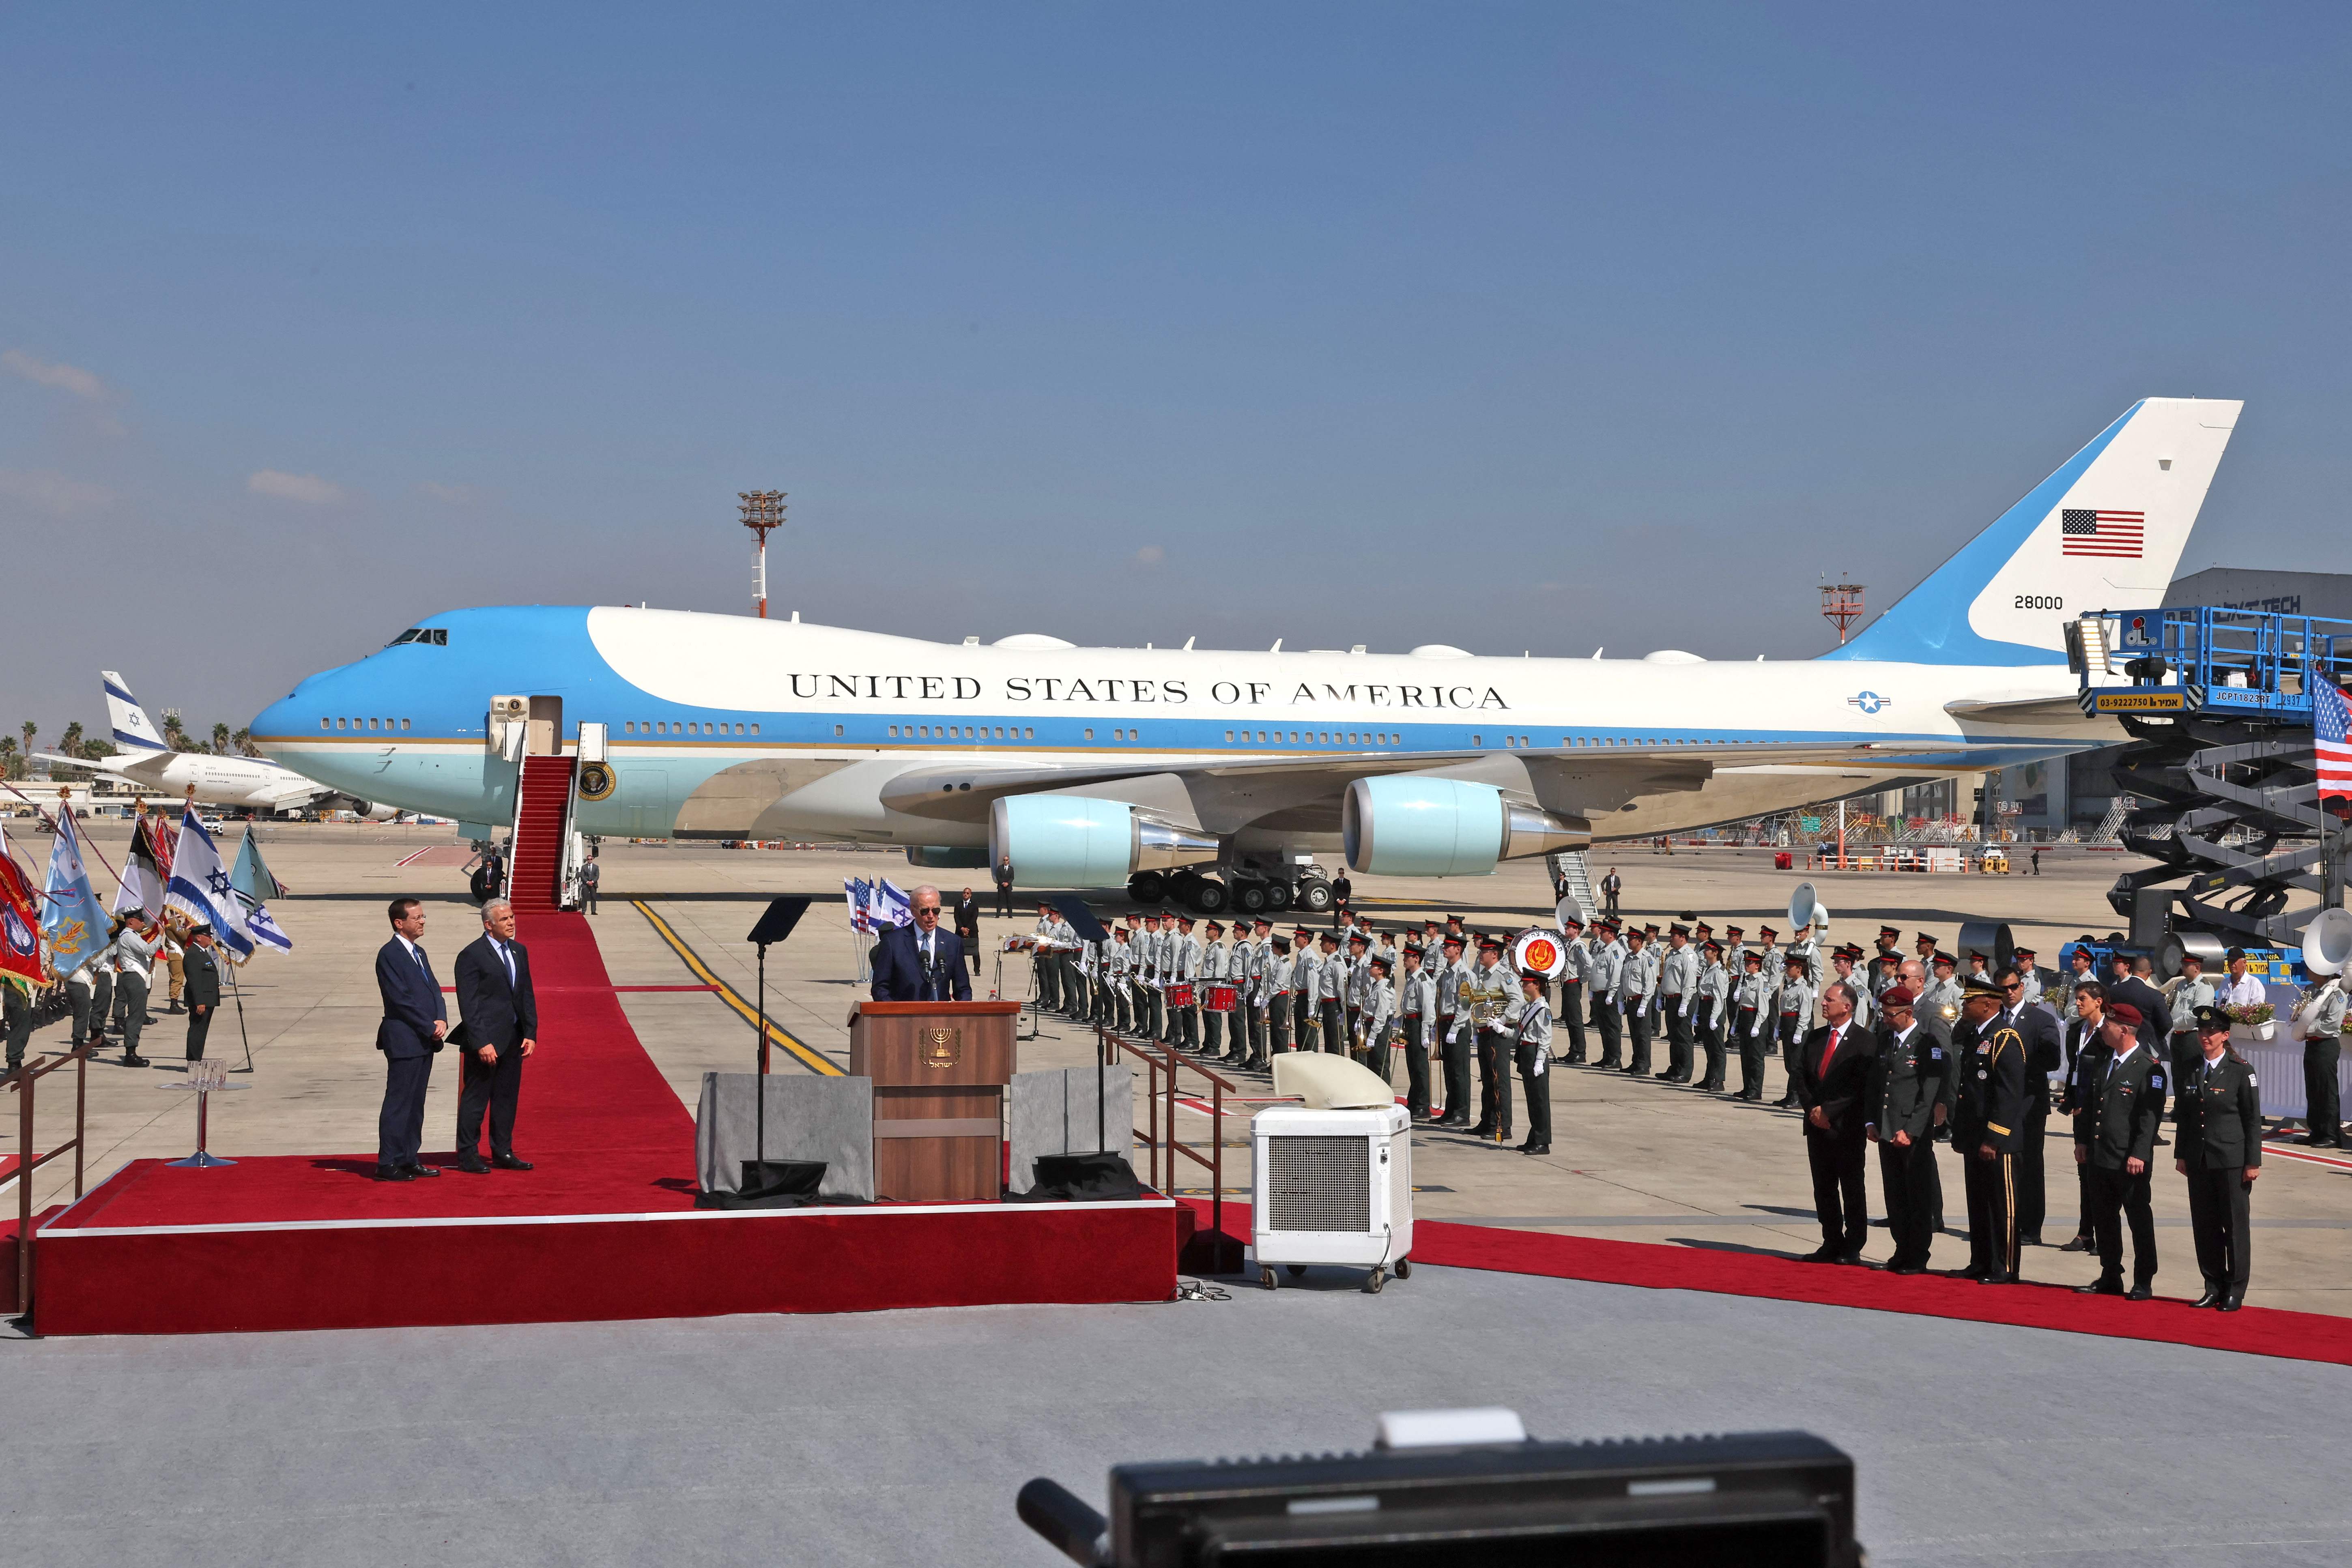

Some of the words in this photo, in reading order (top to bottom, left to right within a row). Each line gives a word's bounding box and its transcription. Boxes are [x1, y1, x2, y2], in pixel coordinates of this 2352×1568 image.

[2015, 595, 2062, 610] 28000
[2262, 595, 2300, 614] TECH
[787, 674, 980, 699] UNITED
[1006, 678, 1188, 703] STATES
[1212, 682, 1271, 703] OF
[1293, 683, 1509, 709] AMERICA
[2216, 692, 2270, 703] JCPT1823RT
[2100, 698, 2148, 707] 03-9222750
[2282, 695, 2300, 706] 2937
[604, 767, 614, 785] UNITED
[598, 787, 612, 799] STATES
[1543, 932, 1563, 952] תזמורת
[2255, 964, 2269, 973] אמיר
[929, 1059, 952, 1068] ישראל
